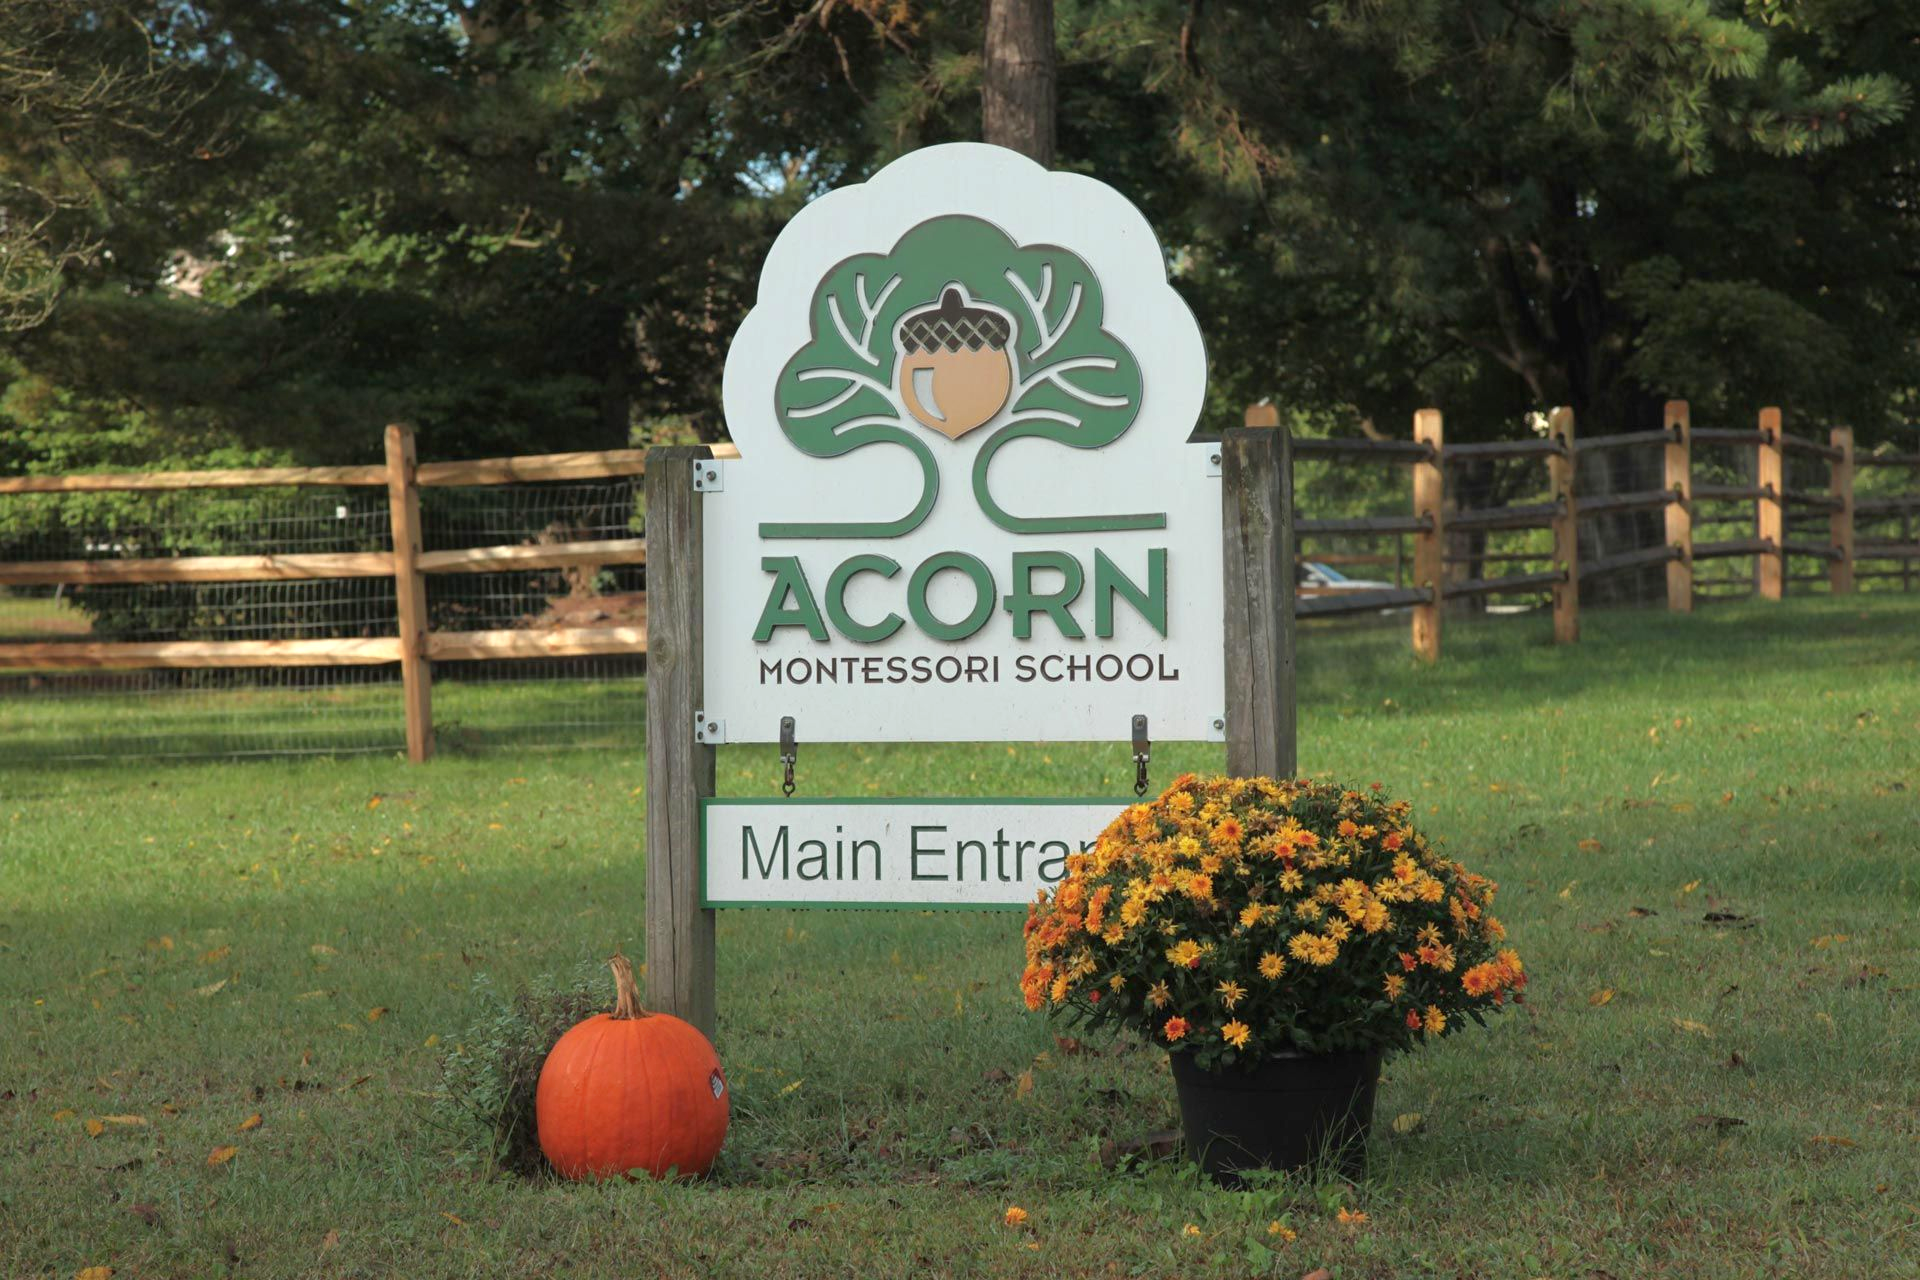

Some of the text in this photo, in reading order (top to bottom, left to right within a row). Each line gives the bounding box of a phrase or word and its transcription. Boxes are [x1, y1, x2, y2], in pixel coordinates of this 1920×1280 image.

[752, 547, 1168, 643] ACORN
[760, 653, 1180, 685] MONTESSORI SCHOOL
[741, 825, 882, 882] Main
